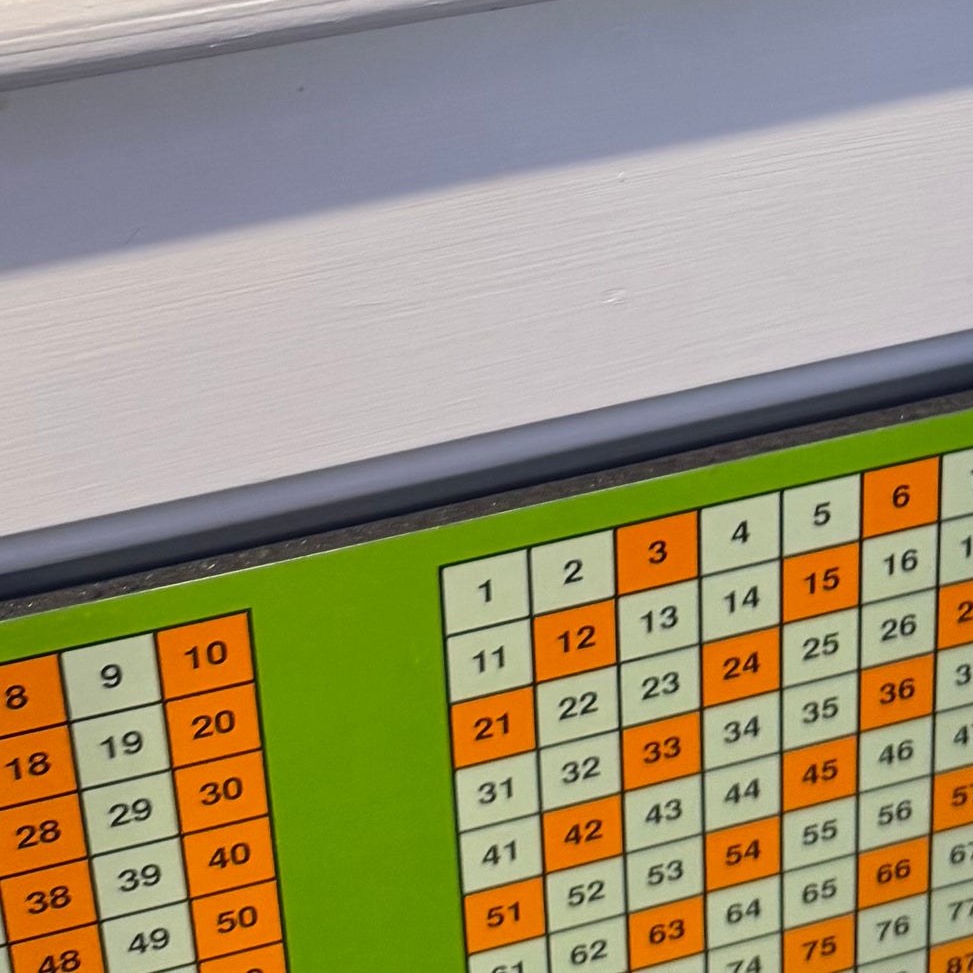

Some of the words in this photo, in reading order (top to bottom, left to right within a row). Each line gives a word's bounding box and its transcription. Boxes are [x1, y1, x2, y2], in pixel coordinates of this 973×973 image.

[477, 578, 492, 603] 1
[563, 559, 584, 586] 2
[648, 540, 668, 565] 3
[730, 519, 751, 544] 4
[813, 501, 832, 527] 5
[892, 484, 910, 509] 6
[472, 645, 505, 674] 11
[558, 625, 596, 653] 12
[640, 605, 679, 634] 13
[723, 585, 761, 614] 14
[805, 567, 840, 595] 15
[883, 548, 919, 577] 16
[4, 684, 29, 710] 8
[99, 663, 124, 690] 9
[184, 640, 227, 670] 10
[474, 713, 509, 741] 21
[558, 691, 599, 722] 22
[641, 671, 681, 701] 23
[723, 652, 760, 681] 24
[802, 631, 840, 662] 25
[880, 613, 918, 643] 26
[5, 751, 51, 781] 18
[99, 730, 144, 760] 19
[191, 710, 235, 740] 20
[477, 776, 513, 805] 31
[561, 756, 601, 785] 32
[644, 737, 681, 764] 33
[723, 715, 761, 745] 34
[801, 696, 839, 725] 35
[879, 678, 915, 705] 36
[15, 819, 61, 850] 28
[107, 797, 153, 829] 29
[199, 777, 243, 806] 30
[481, 839, 517, 866] 41
[564, 819, 602, 845] 42
[644, 798, 683, 825] 43
[723, 777, 761, 805] 44
[802, 759, 838, 784] 45
[877, 739, 914, 766] 46
[25, 885, 72, 915] 38
[117, 863, 162, 893] 39
[208, 842, 250, 869] 40
[487, 902, 520, 928] 51
[567, 879, 606, 908] 52
[647, 859, 684, 887] 53
[726, 840, 760, 866] 54
[802, 818, 838, 847] 55
[877, 799, 913, 827] 56
[569, 939, 608, 966] 62
[648, 919, 685, 945] 63
[725, 898, 762, 926] 64
[801, 877, 838, 905] 65
[876, 859, 911, 884] 66
[37, 949, 81, 973] 48
[127, 927, 171, 955] 49
[217, 906, 258, 934] 50
[804, 936, 837, 961] 75
[876, 914, 911, 942] 76
